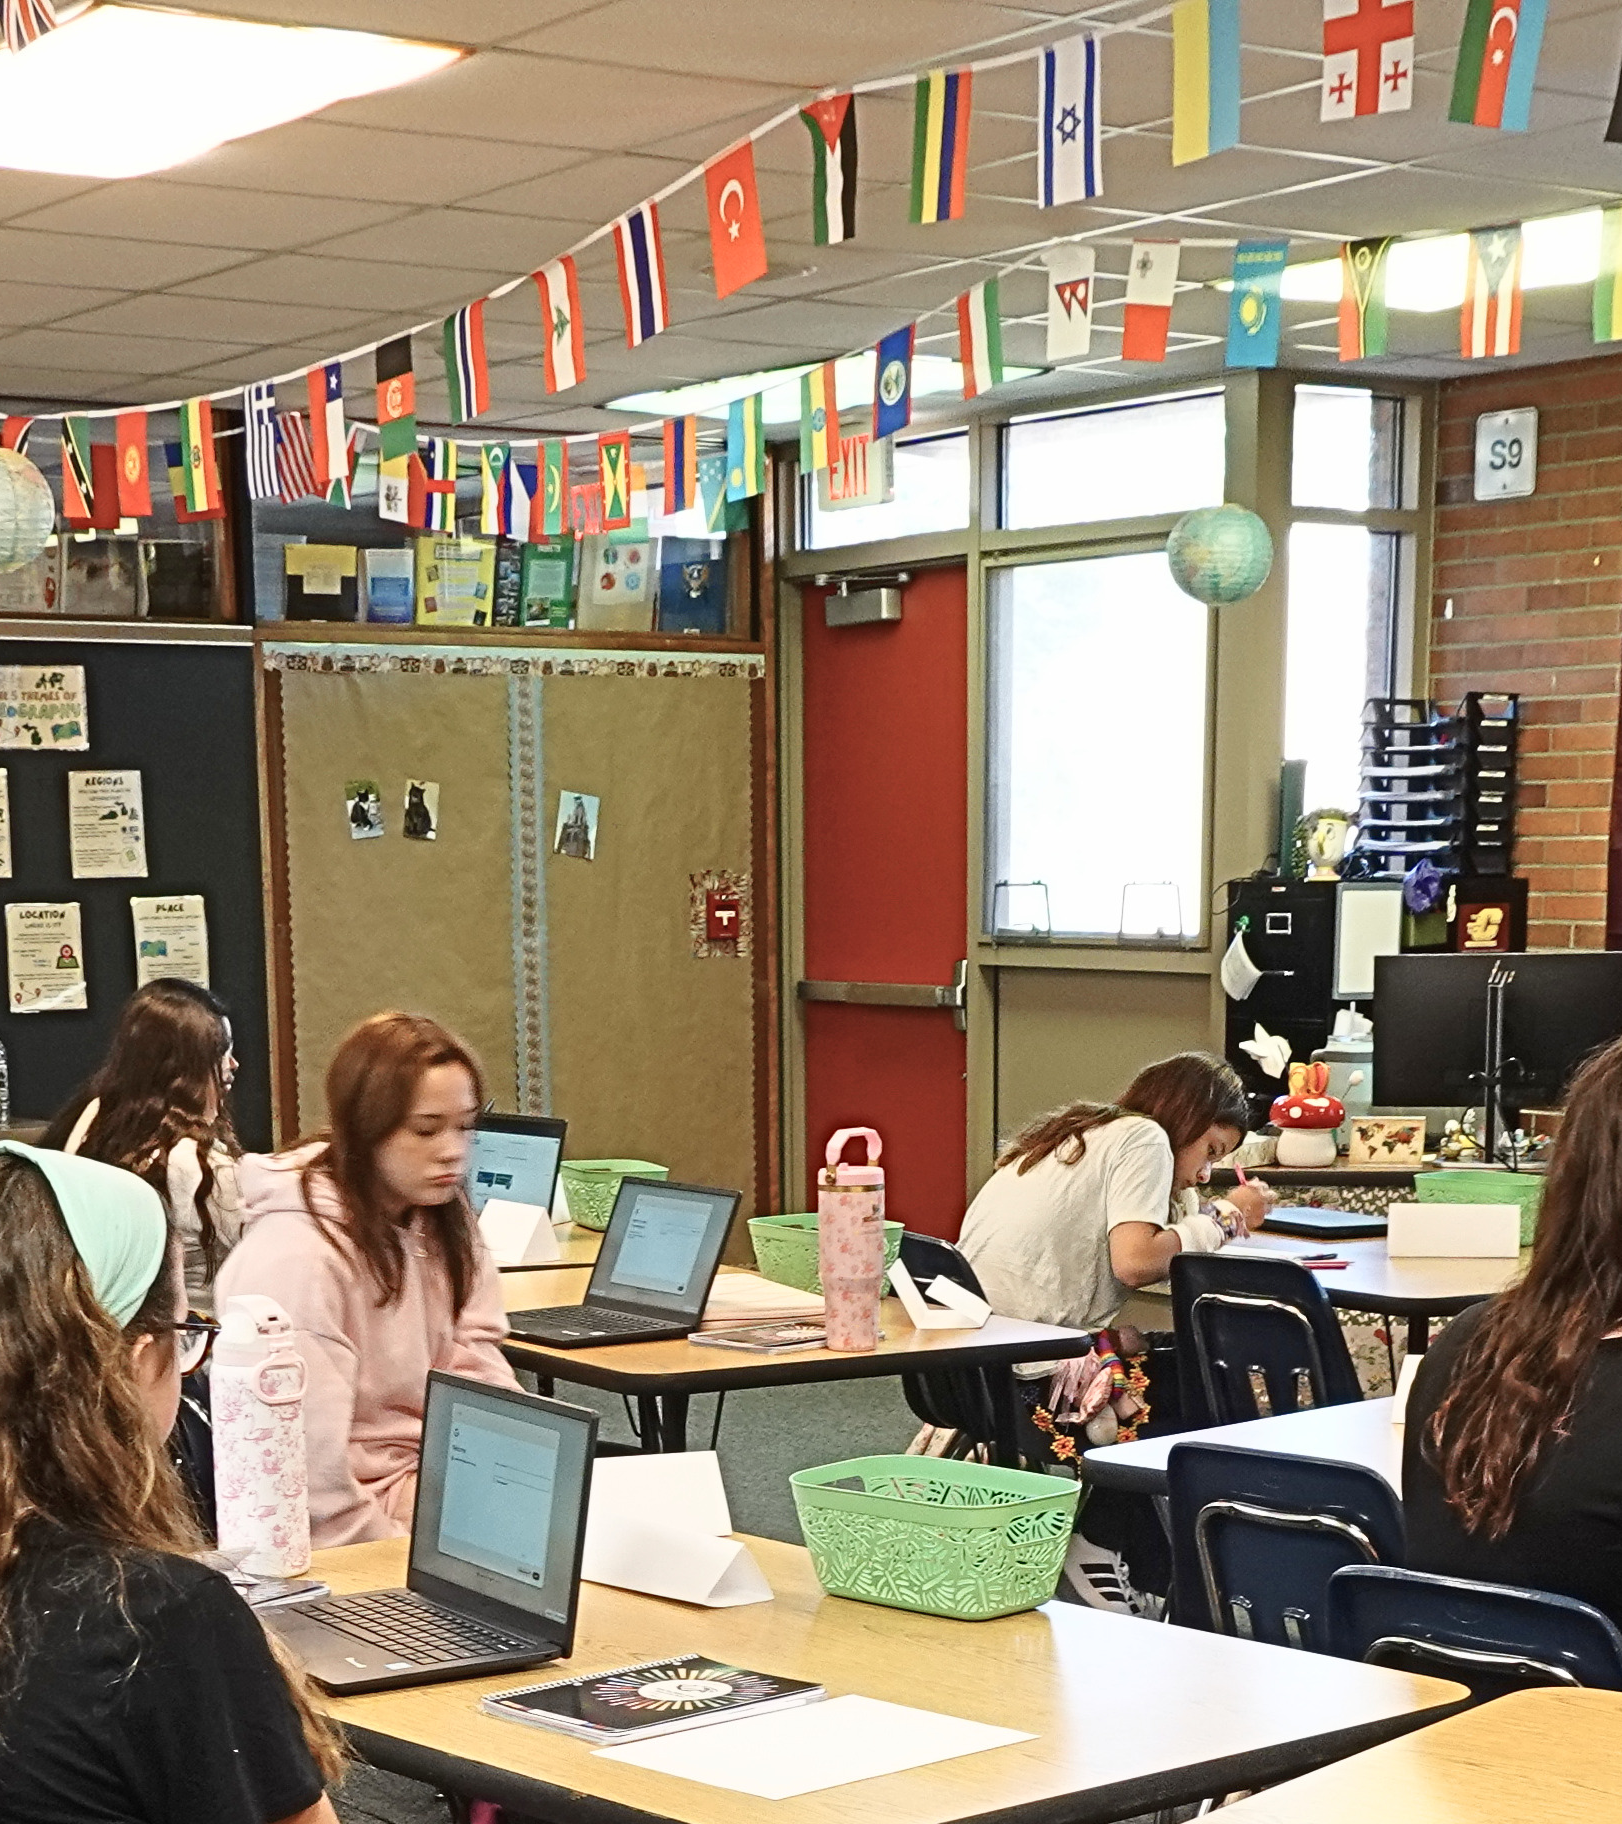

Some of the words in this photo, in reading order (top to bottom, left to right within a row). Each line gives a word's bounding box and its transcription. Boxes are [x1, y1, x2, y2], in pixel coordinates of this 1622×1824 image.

[1488, 437, 1524, 470] S9
[20, 690, 61, 701] THEMES
[63, 691, 78, 701] OF
[84, 776, 125, 787] REGIONS
[155, 903, 185, 914] PLACE
[19, 910, 66, 920] LOCATION
